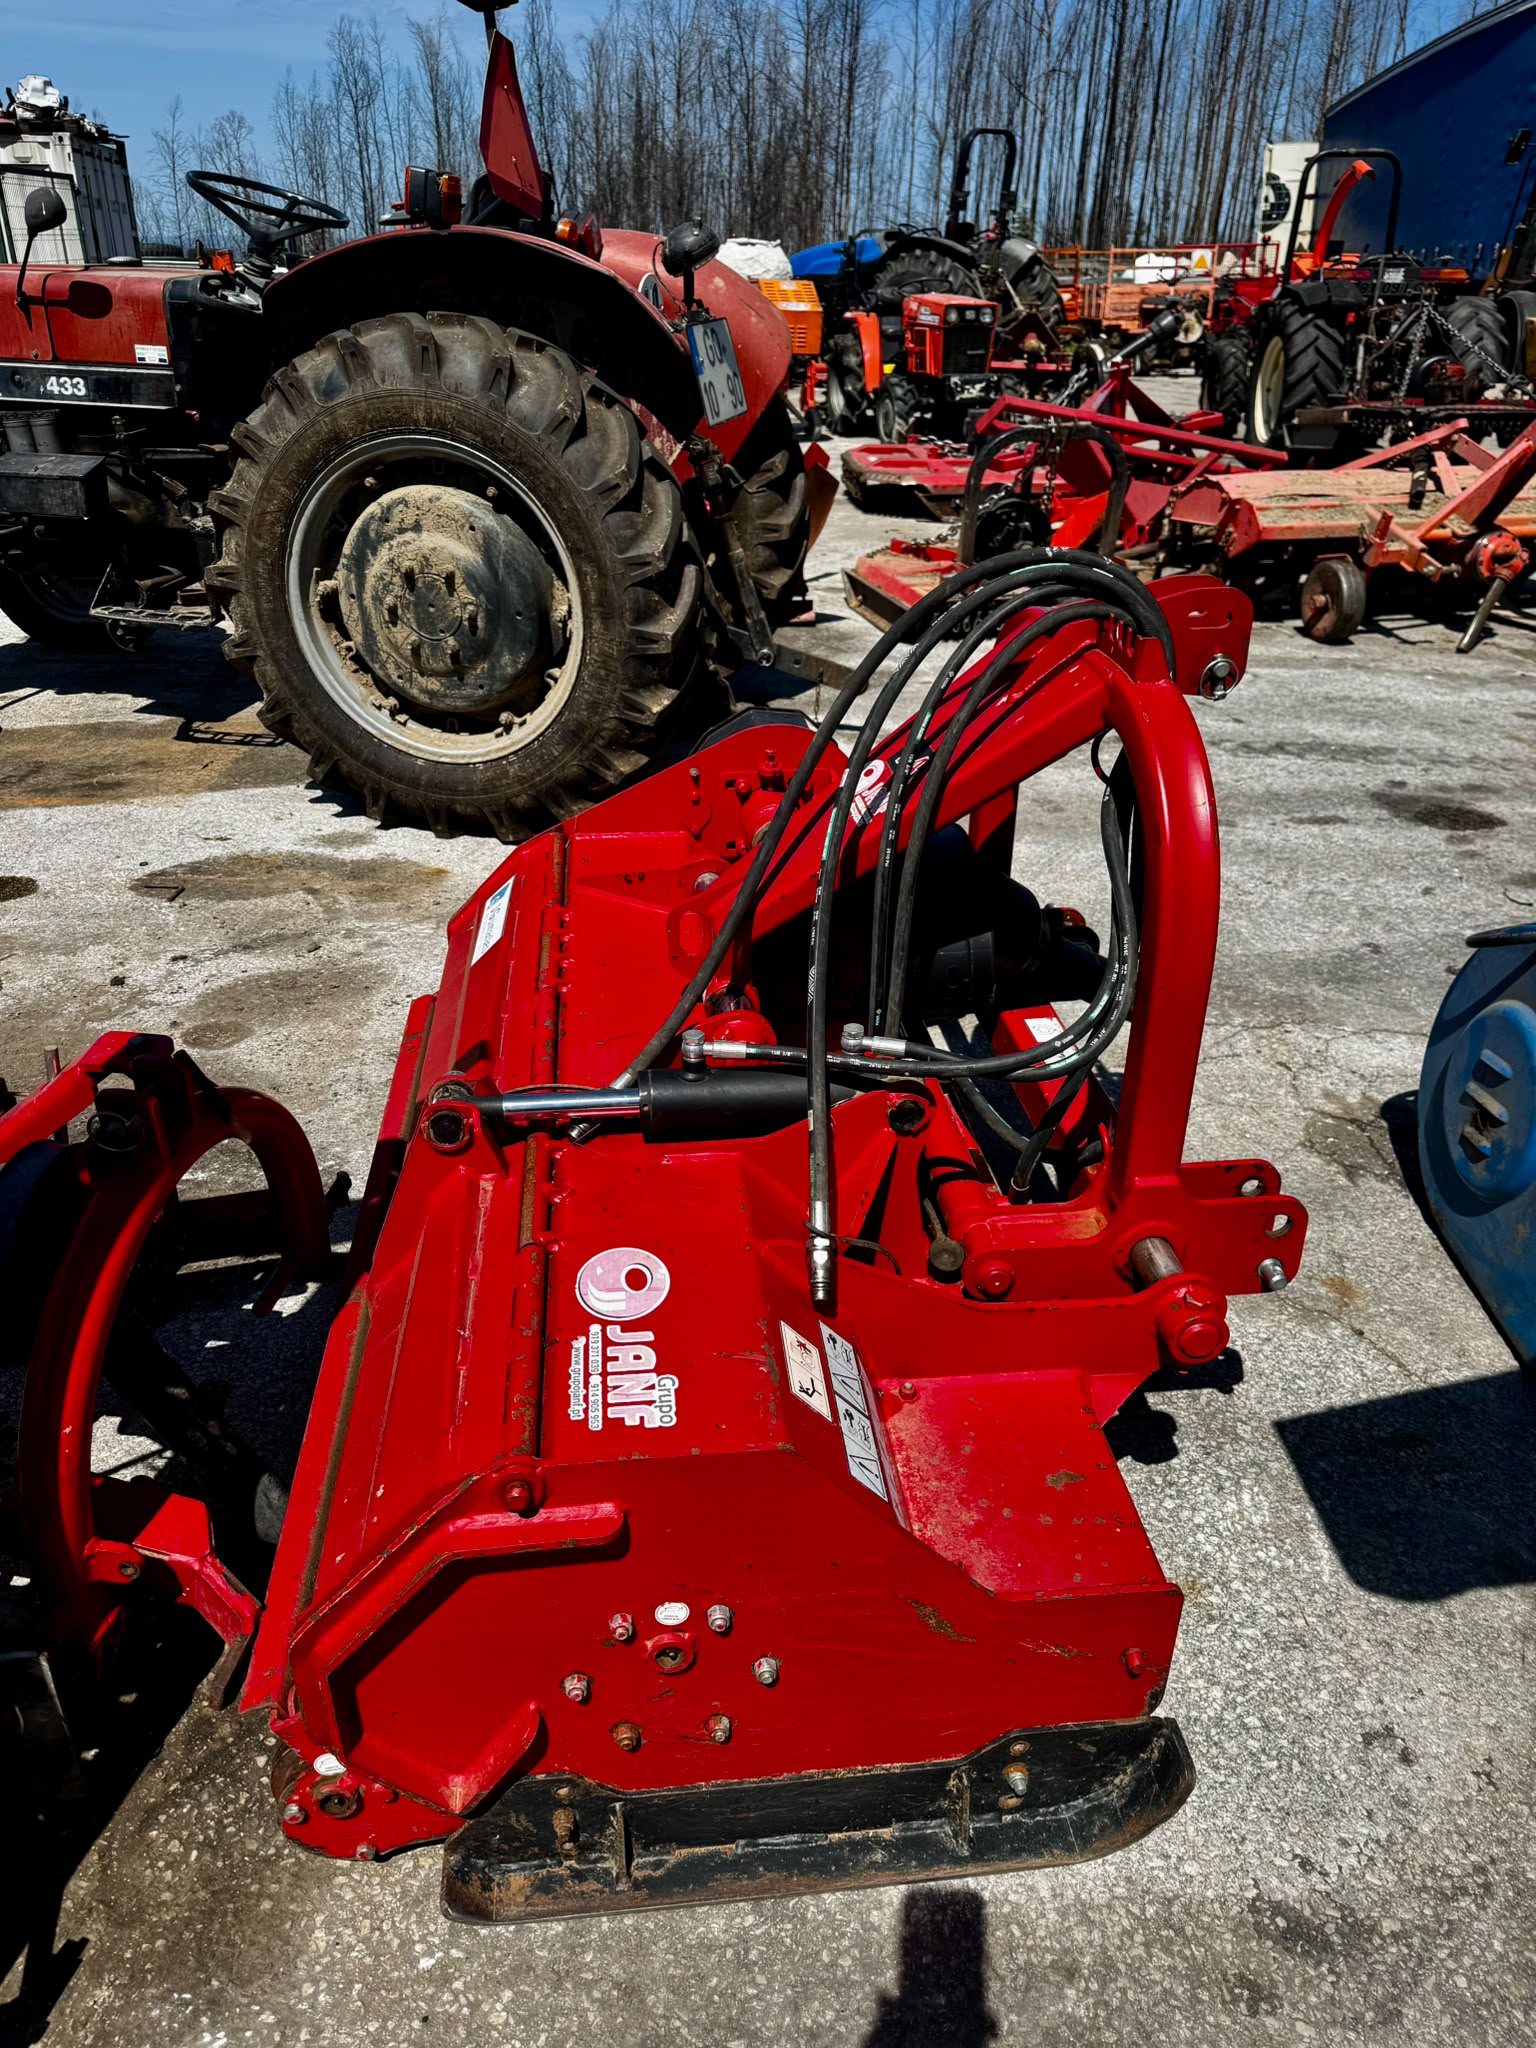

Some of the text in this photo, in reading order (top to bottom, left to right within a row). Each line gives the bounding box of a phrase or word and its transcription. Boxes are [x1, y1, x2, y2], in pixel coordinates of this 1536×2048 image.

[46, 376, 87, 396] 433
[590, 1331, 600, 1373] 919 371 039
[569, 1346, 583, 1419] www.grupojanf.pt
[606, 1325, 657, 1428] JANF
[654, 1375, 676, 1425] Grupo
[590, 1383, 600, 1430] 914 905 953
